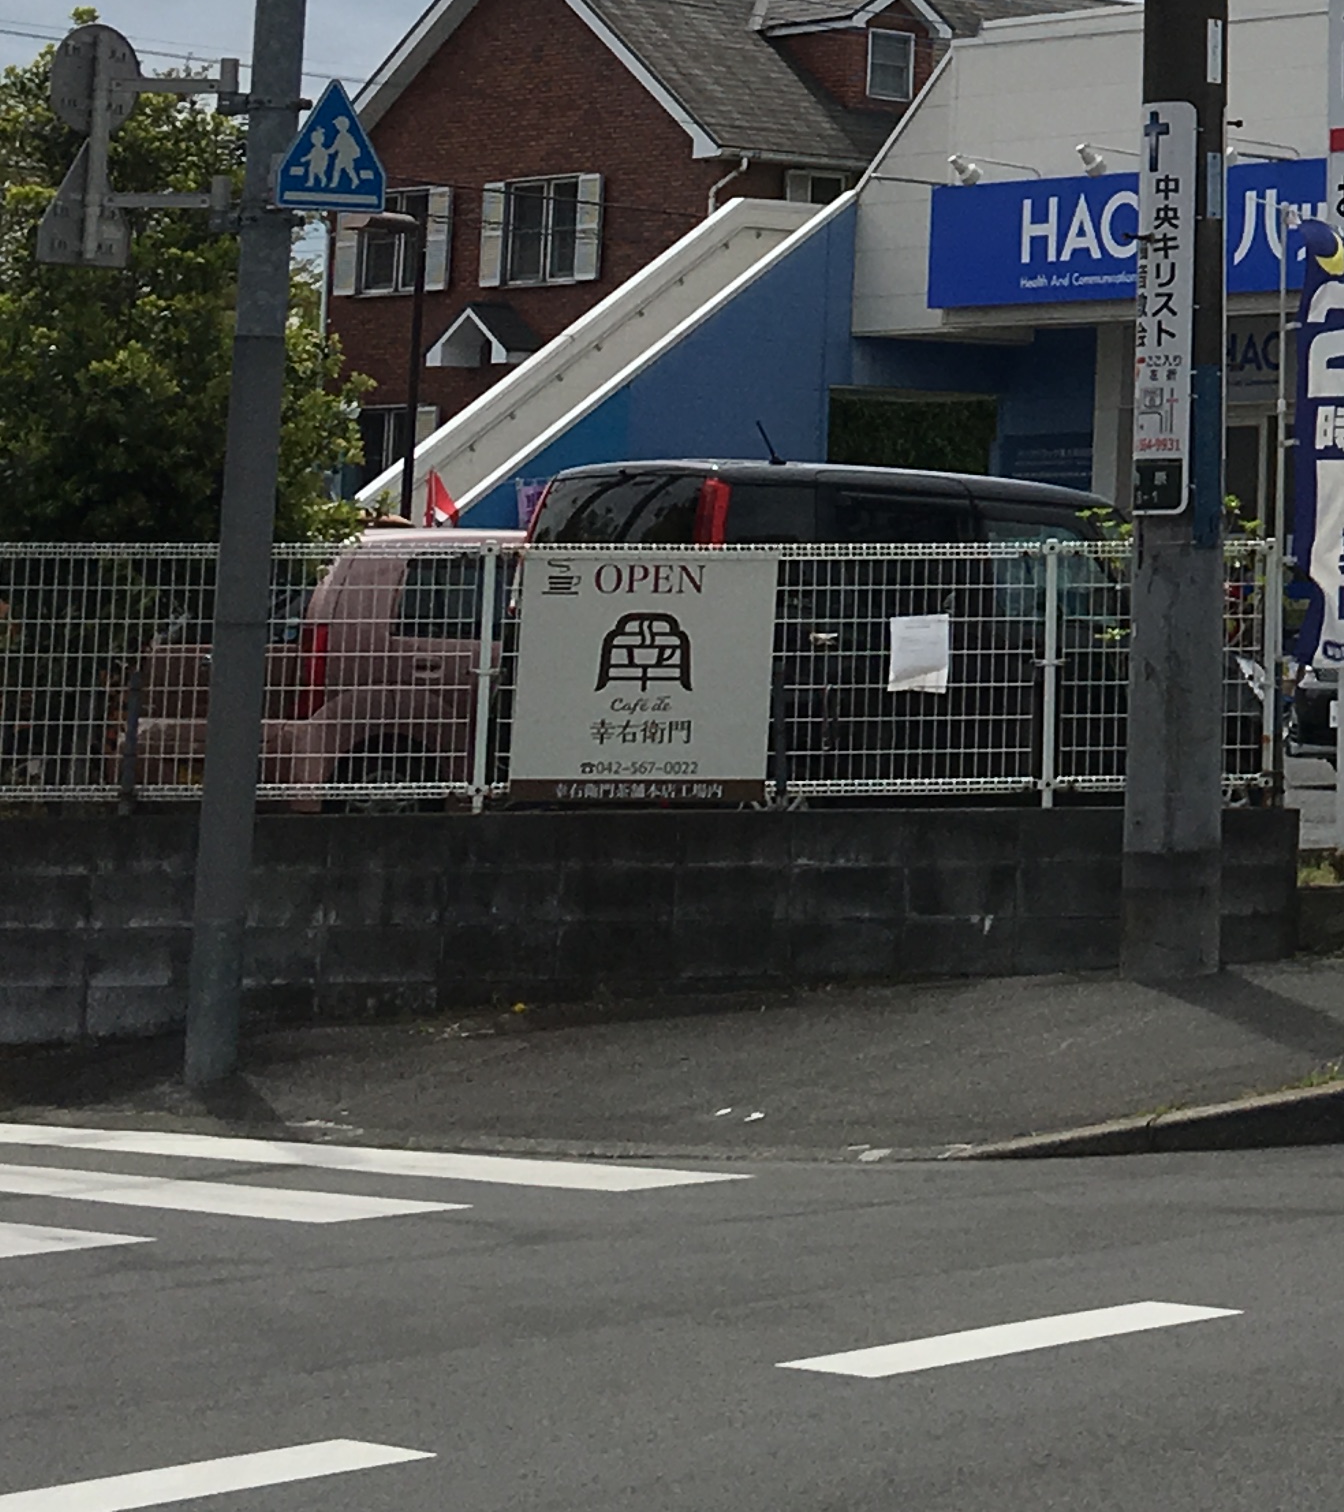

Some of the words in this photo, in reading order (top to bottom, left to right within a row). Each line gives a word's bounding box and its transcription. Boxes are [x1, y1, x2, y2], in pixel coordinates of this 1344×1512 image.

[1152, 174, 1181, 347] 中央キリスト
[594, 563, 706, 595] OPEN
[590, 718, 693, 745] 幸右衛門
[596, 761, 699, 775] 042-567-0022
